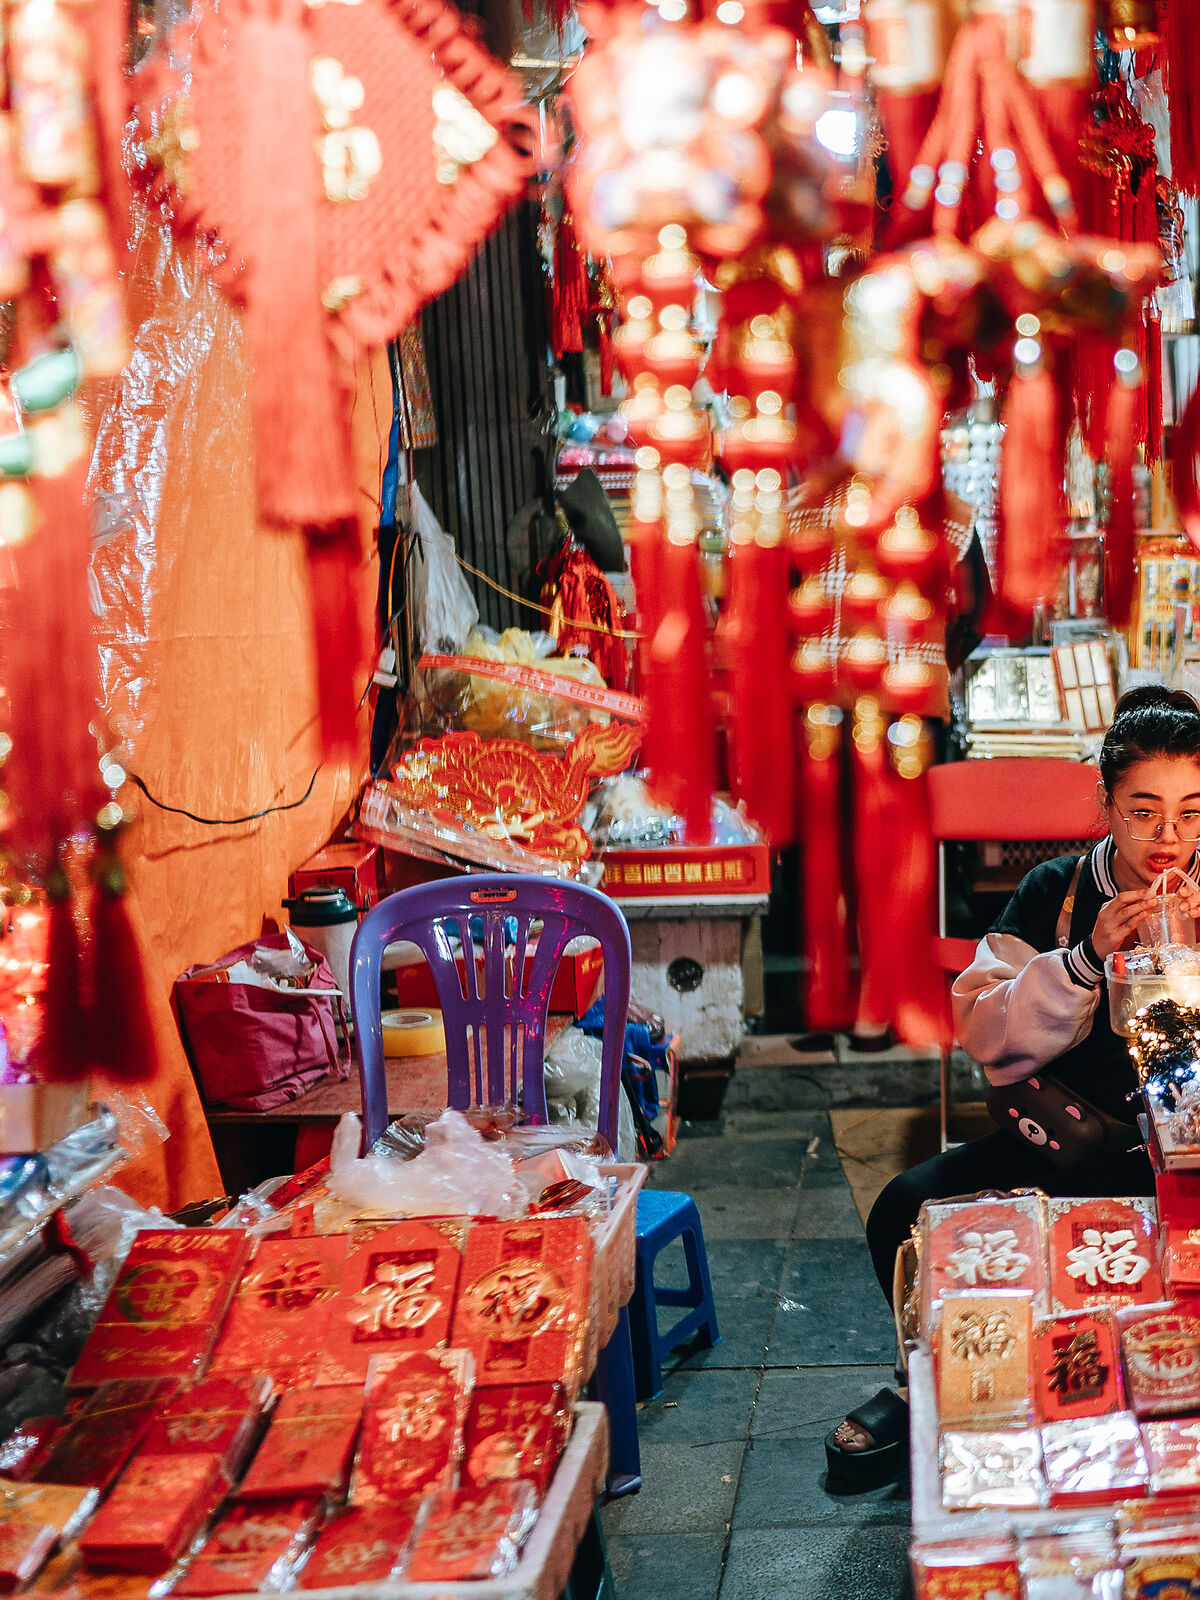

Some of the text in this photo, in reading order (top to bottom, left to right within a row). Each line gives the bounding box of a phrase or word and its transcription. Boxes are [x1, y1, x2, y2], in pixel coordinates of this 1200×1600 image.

[945, 1229, 1031, 1285] 福
[1065, 1228, 1151, 1286] 福
[347, 1261, 443, 1332] 福
[1043, 1340, 1110, 1393] 福
[1146, 1337, 1194, 1372] 福
[375, 1388, 447, 1442] 福
